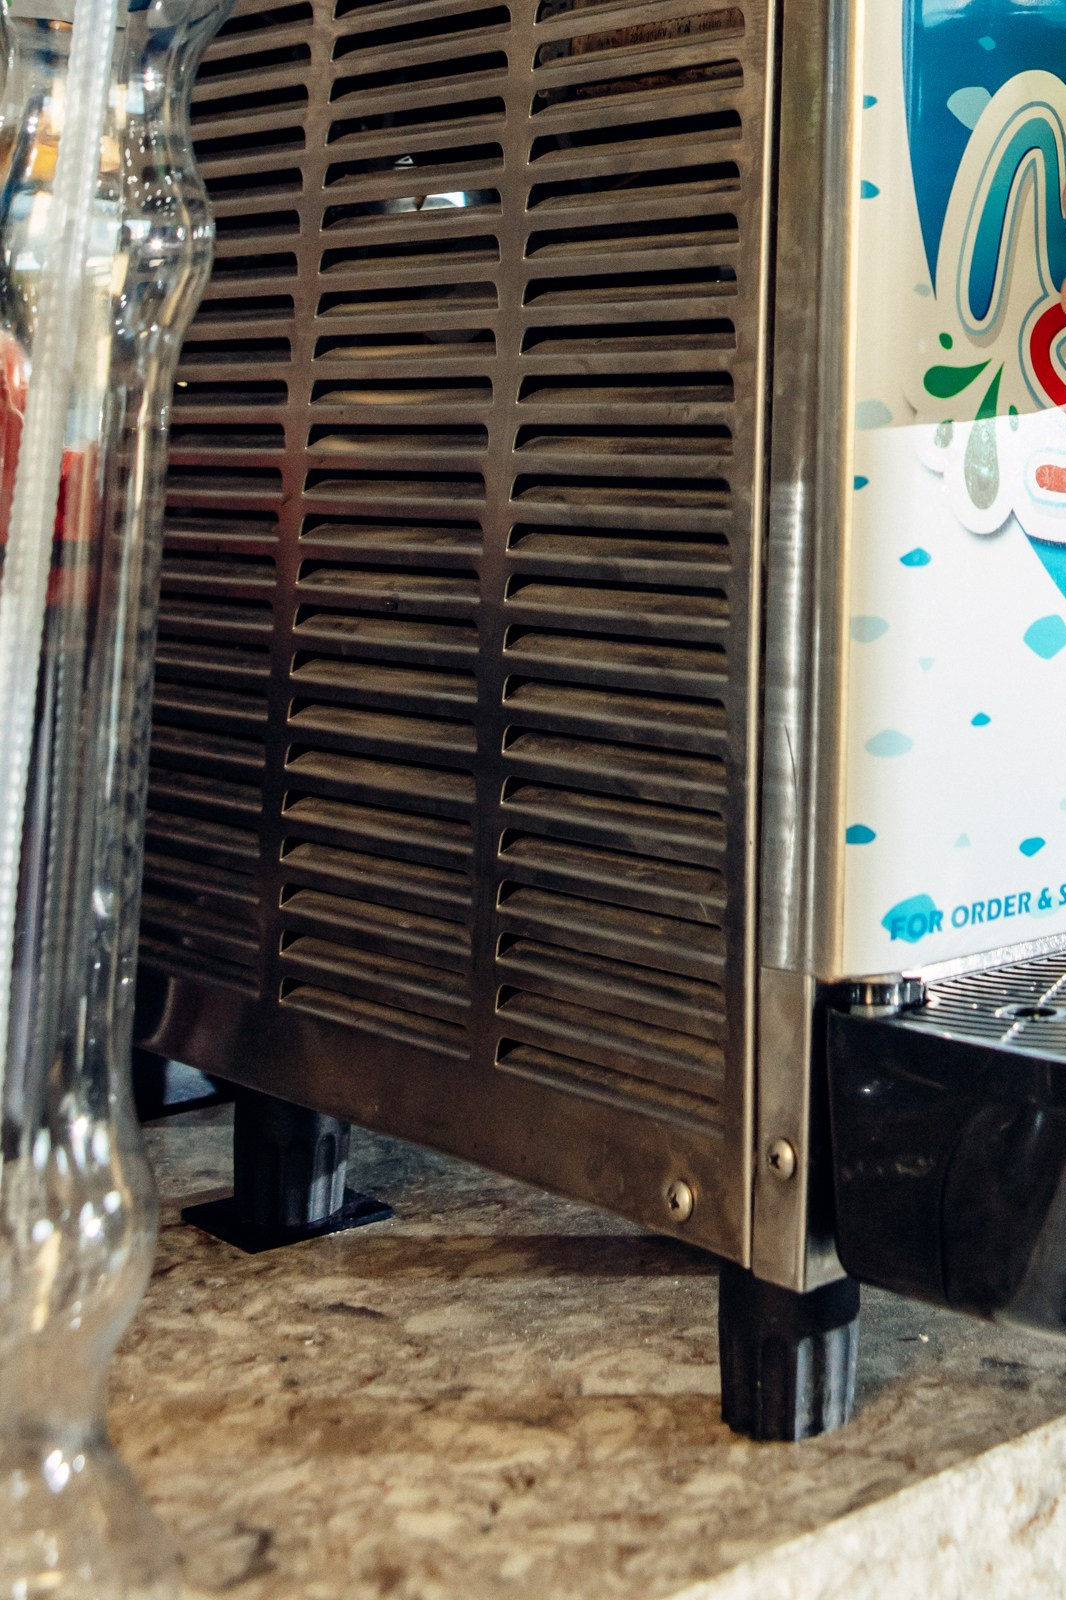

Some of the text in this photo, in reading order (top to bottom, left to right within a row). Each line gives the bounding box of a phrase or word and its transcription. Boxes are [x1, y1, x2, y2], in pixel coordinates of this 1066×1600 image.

[890, 909, 944, 941] FOR
[951, 891, 1032, 929] ORDER
[1037, 887, 1052, 910] &
